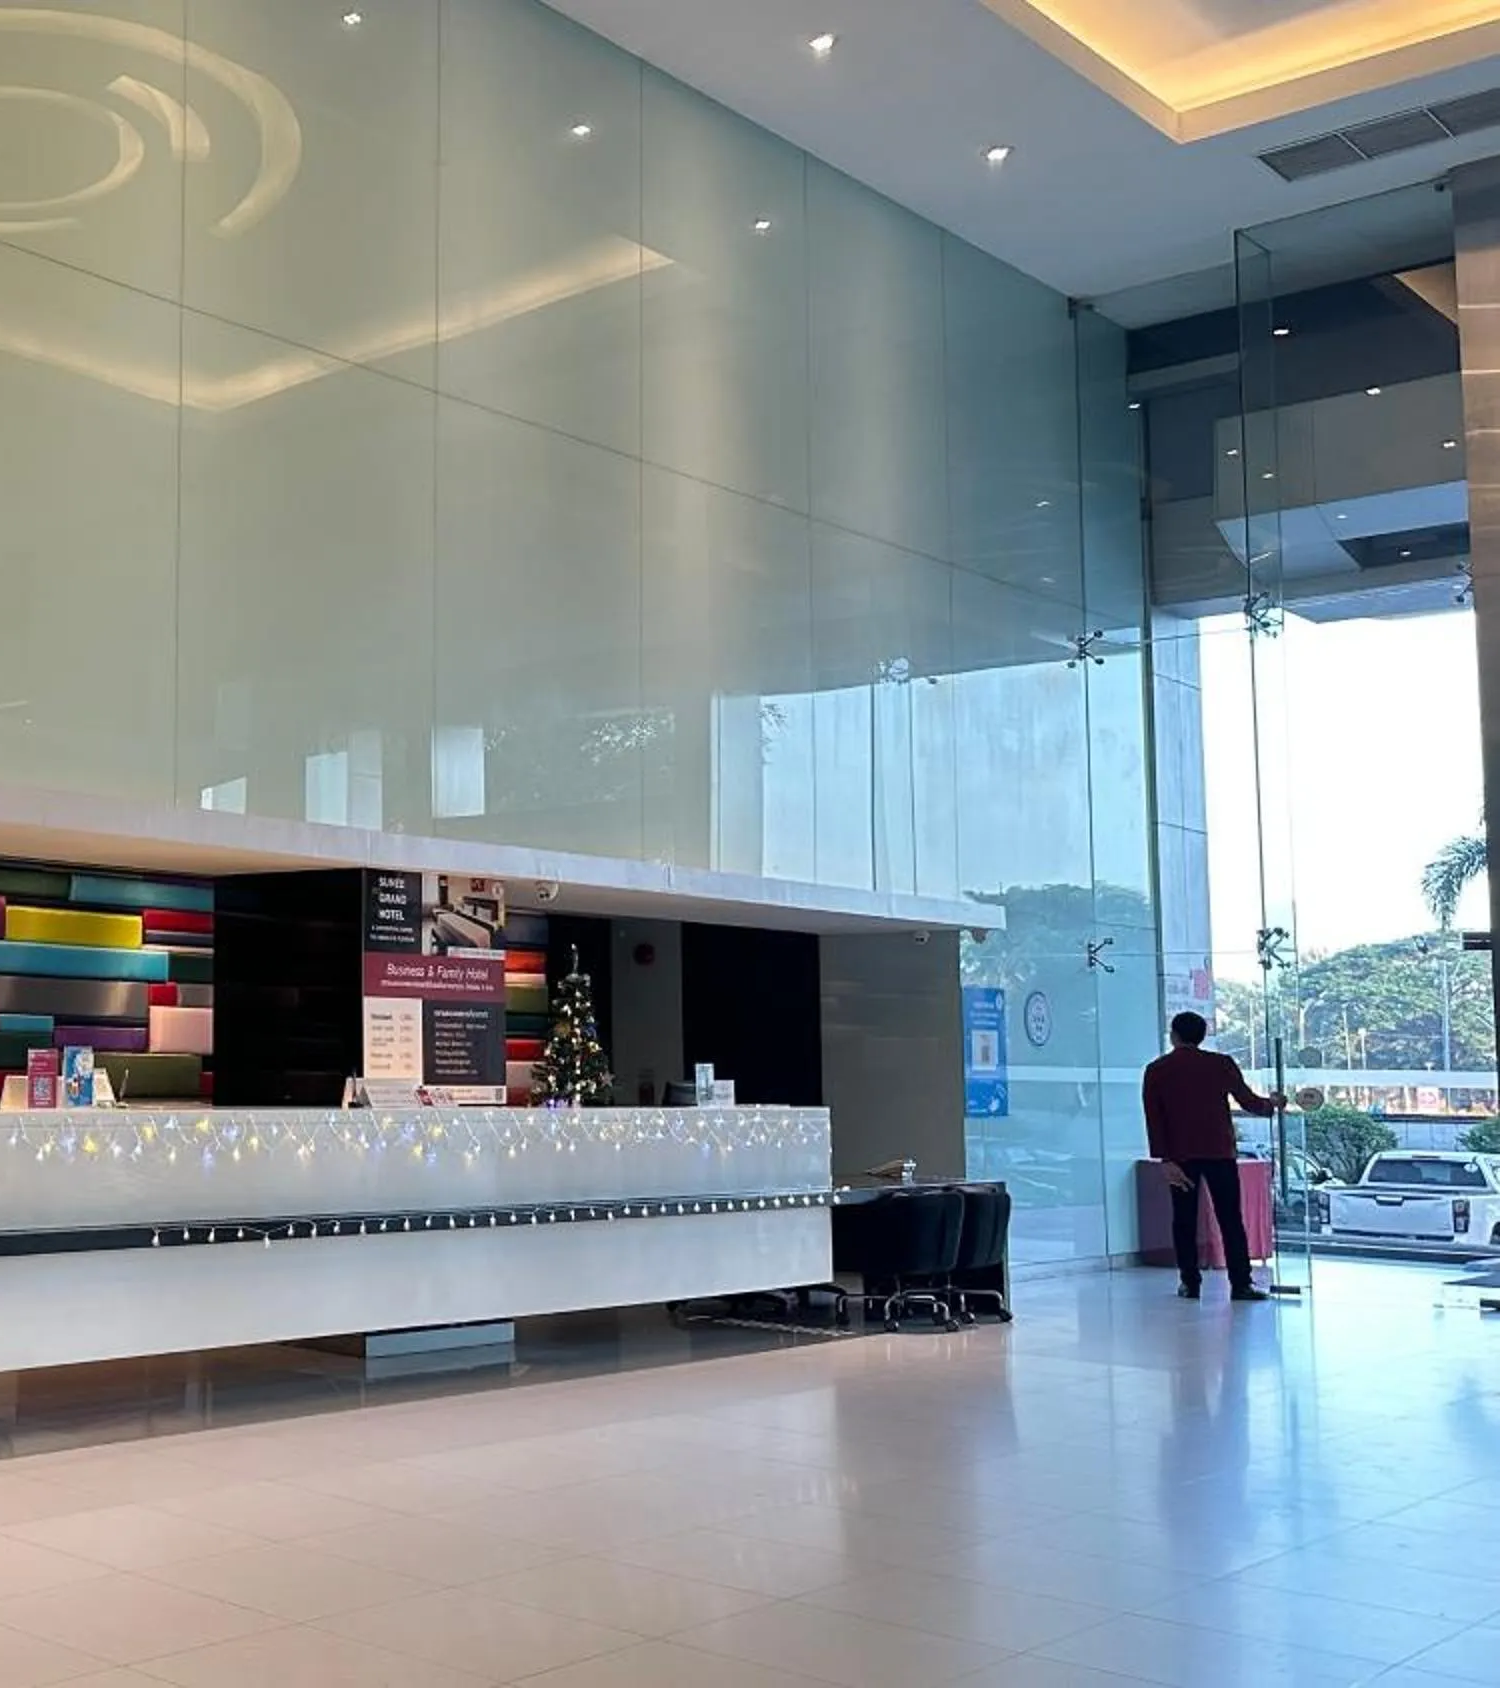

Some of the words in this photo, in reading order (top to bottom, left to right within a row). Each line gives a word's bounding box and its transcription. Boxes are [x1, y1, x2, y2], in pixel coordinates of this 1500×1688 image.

[379, 893, 407, 905] GRAND
[379, 909, 405, 921] HOTEL
[387, 963, 425, 977] Business
[428, 966, 435, 977] &
[436, 966, 465, 981] Family
[466, 968, 489, 980] Hotel
